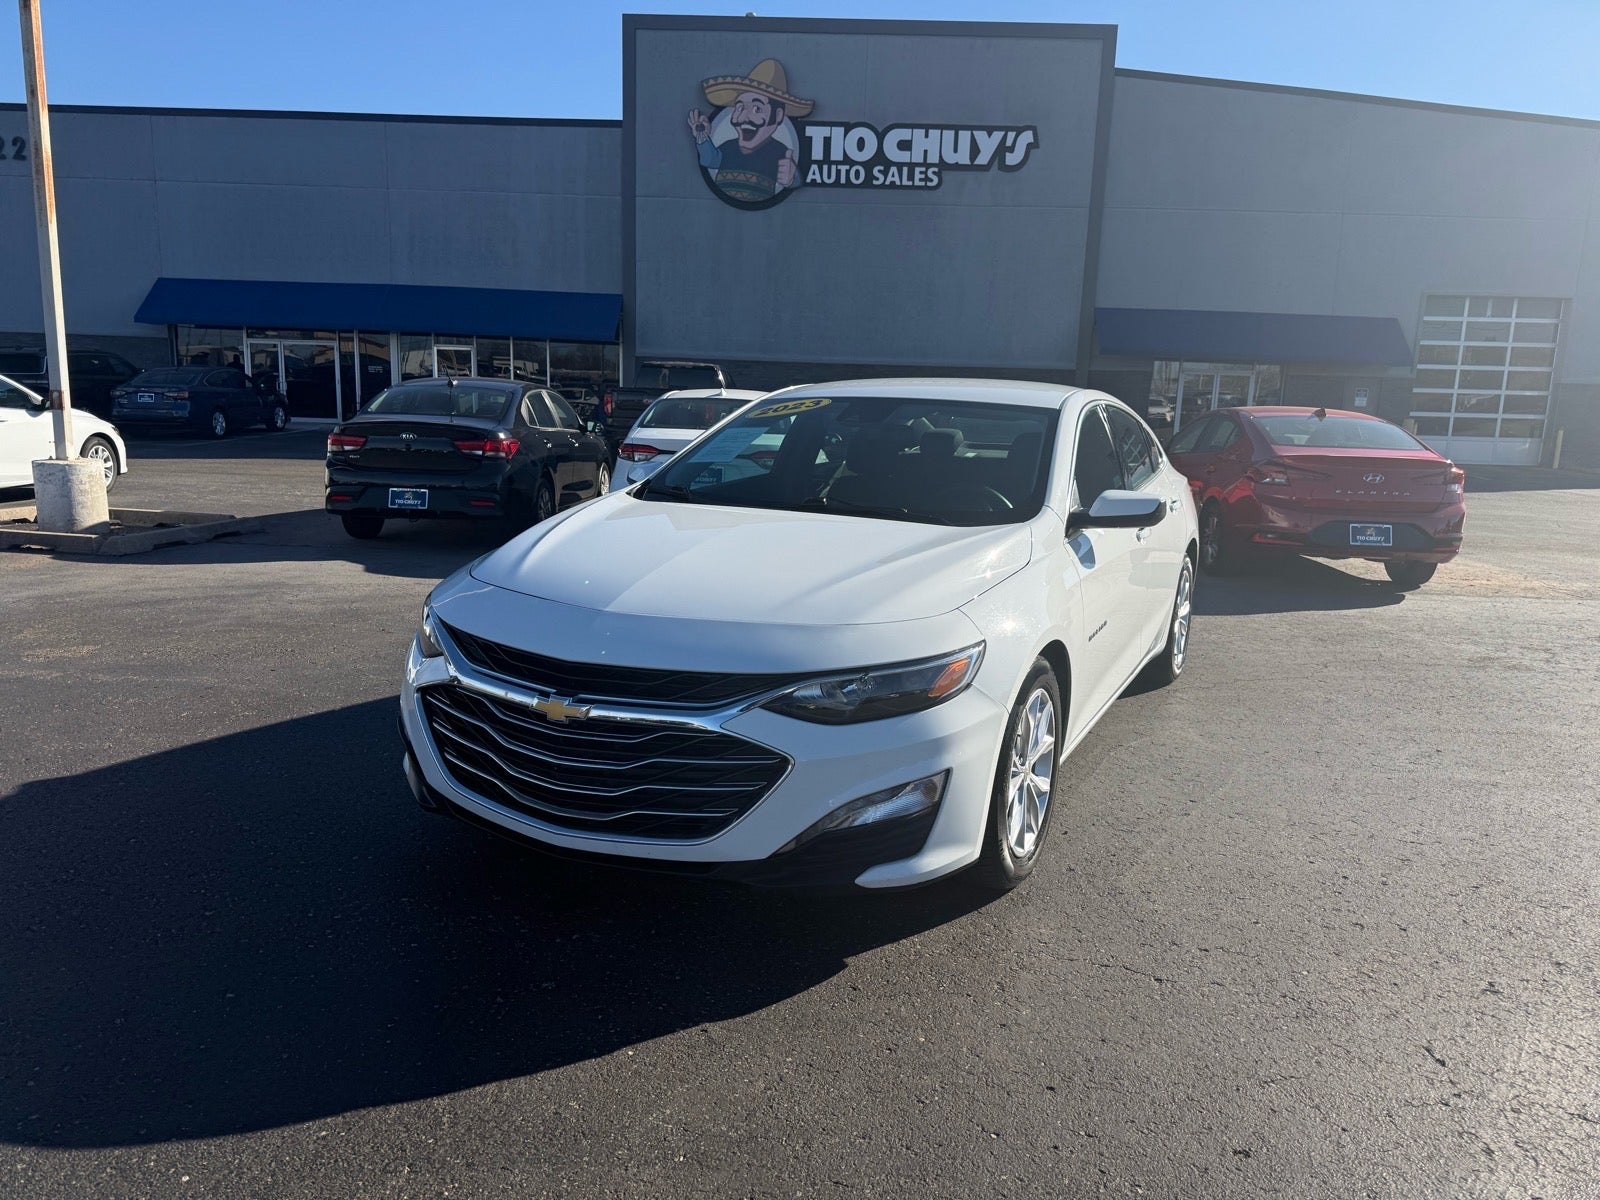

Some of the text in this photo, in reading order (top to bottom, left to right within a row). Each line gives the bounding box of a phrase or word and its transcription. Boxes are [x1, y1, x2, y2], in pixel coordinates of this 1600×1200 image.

[805, 126, 1034, 166] TIO CHUY'S
[806, 165, 939, 187] AUTO SALES
[754, 399, 824, 416] 2023
